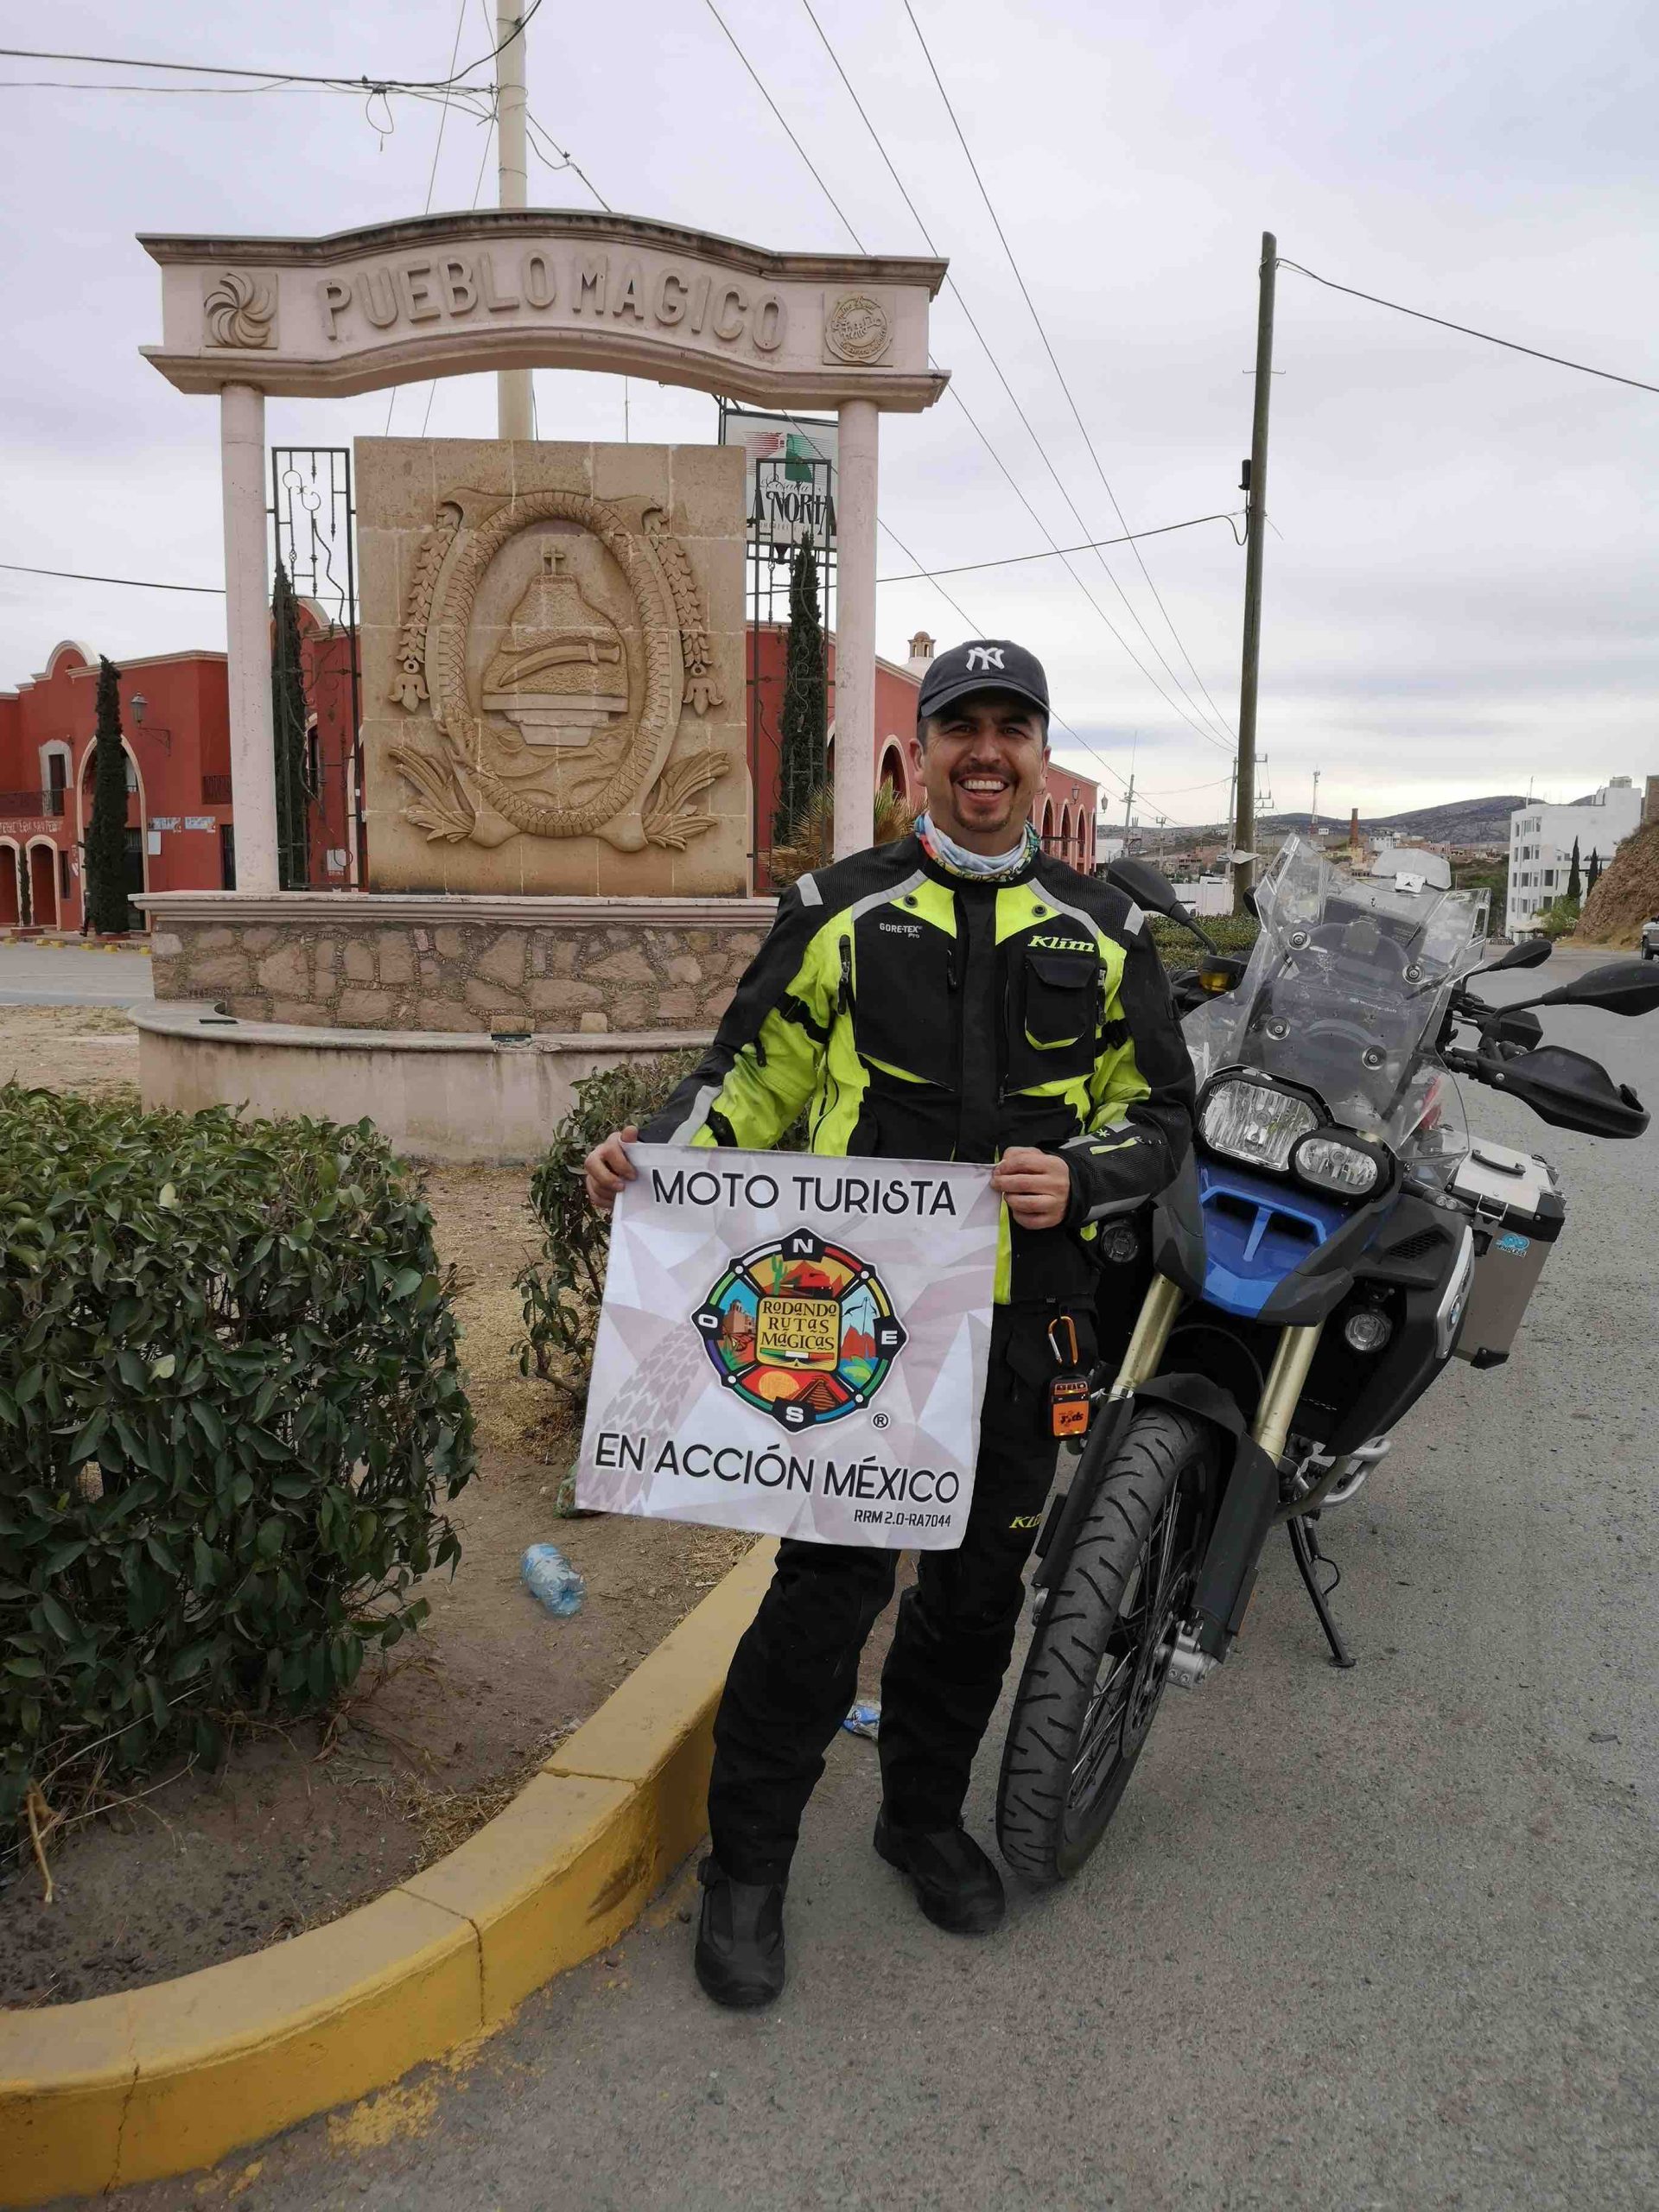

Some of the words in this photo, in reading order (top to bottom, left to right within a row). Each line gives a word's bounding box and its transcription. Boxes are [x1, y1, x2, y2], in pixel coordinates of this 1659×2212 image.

[316, 249, 556, 340] PUEBLO
[572, 254, 787, 352] MAGICO
[966, 647, 1005, 671] NY
[652, 1169, 779, 1209] MOTO
[792, 1176, 957, 1216] TURISTA
[792, 1238, 813, 1254] N
[698, 1314, 719, 1329] O
[881, 1330, 898, 1345] E
[785, 1406, 804, 1423] S
[595, 1433, 645, 1471] EN
[654, 1440, 815, 1493] ACCIÓN
[823, 1455, 960, 1504] MÉXICO
[854, 1510, 883, 1523] RRM
[884, 1511, 951, 1527] 2.0-RA7044
